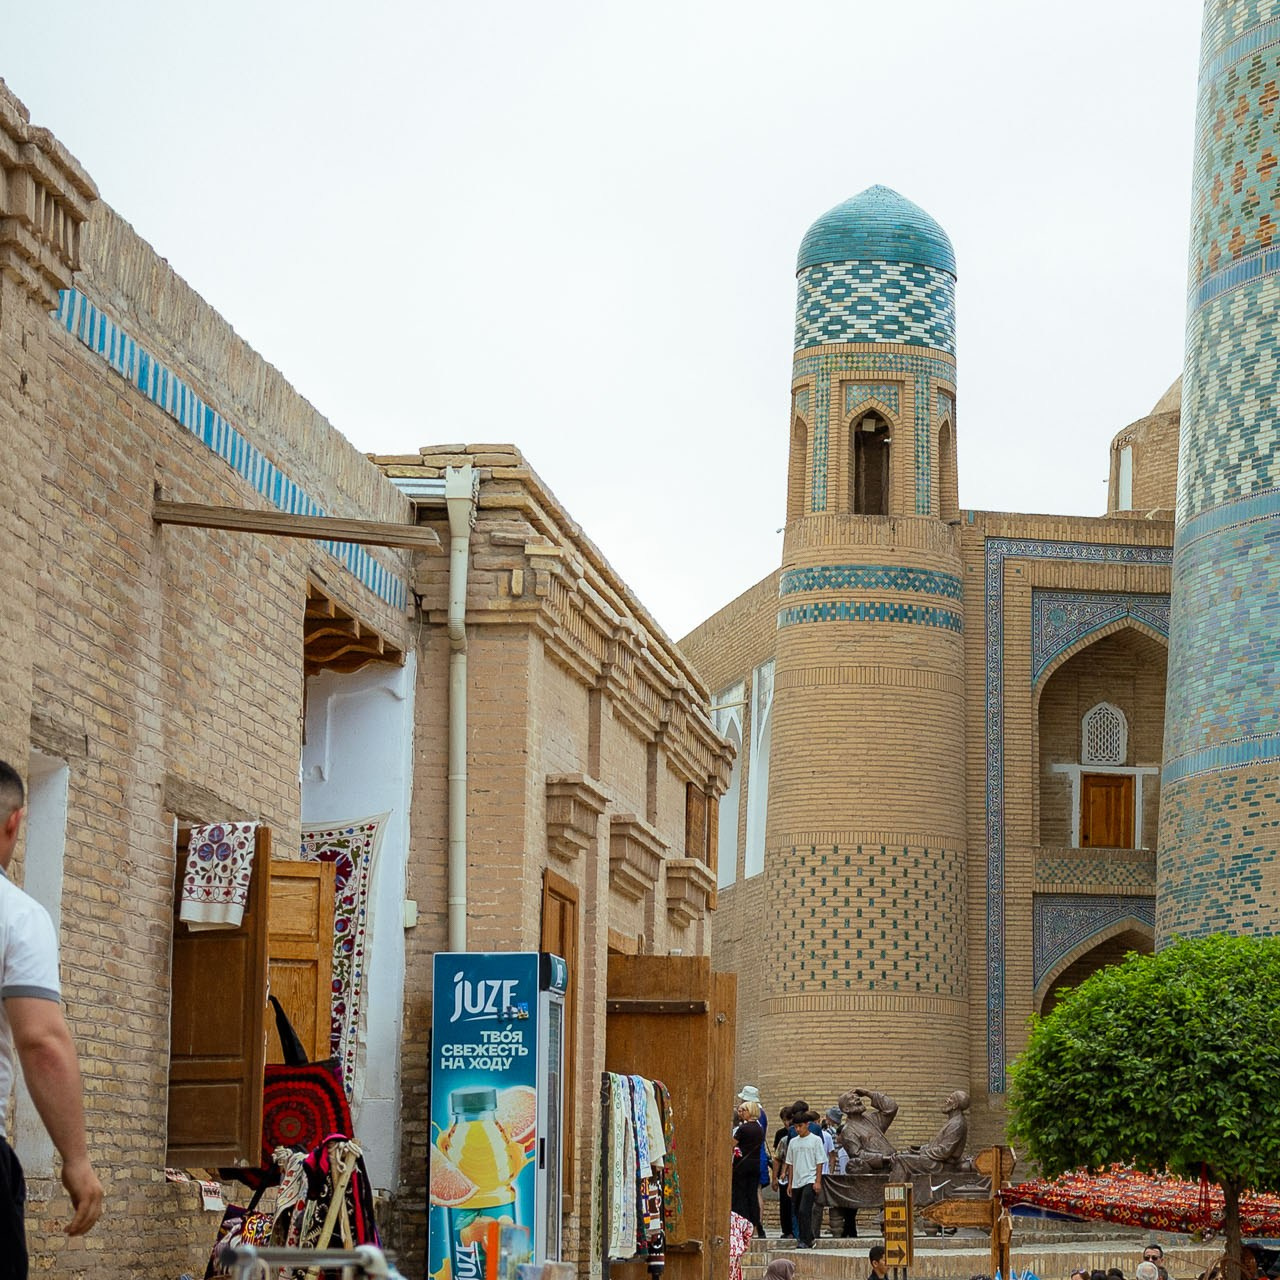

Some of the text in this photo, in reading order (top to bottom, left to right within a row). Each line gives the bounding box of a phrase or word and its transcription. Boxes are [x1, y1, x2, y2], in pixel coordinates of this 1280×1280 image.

[441, 1044, 529, 1056] СВЕЖЕСТЬ
[441, 1057, 513, 1072] НА ХОДУ
